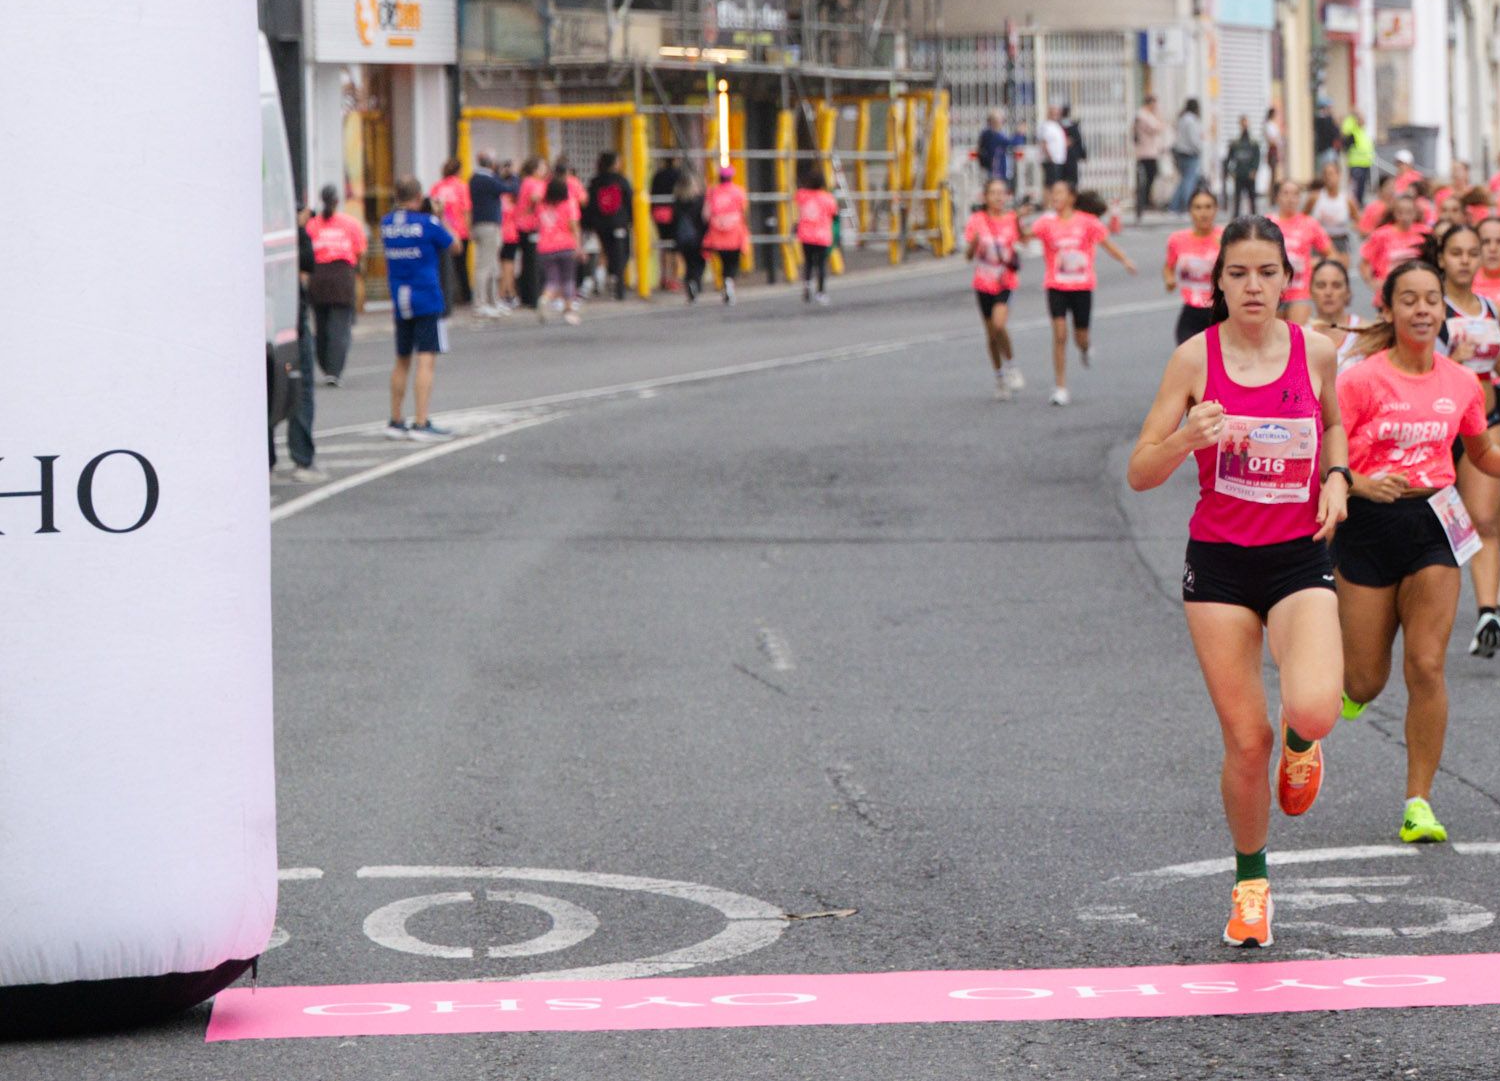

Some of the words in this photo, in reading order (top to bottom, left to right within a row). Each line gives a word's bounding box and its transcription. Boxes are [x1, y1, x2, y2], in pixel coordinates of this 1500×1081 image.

[1248, 457, 1285, 473] 016
[948, 974, 1447, 1001] OYSHO
[302, 992, 817, 1017] OYSHO
